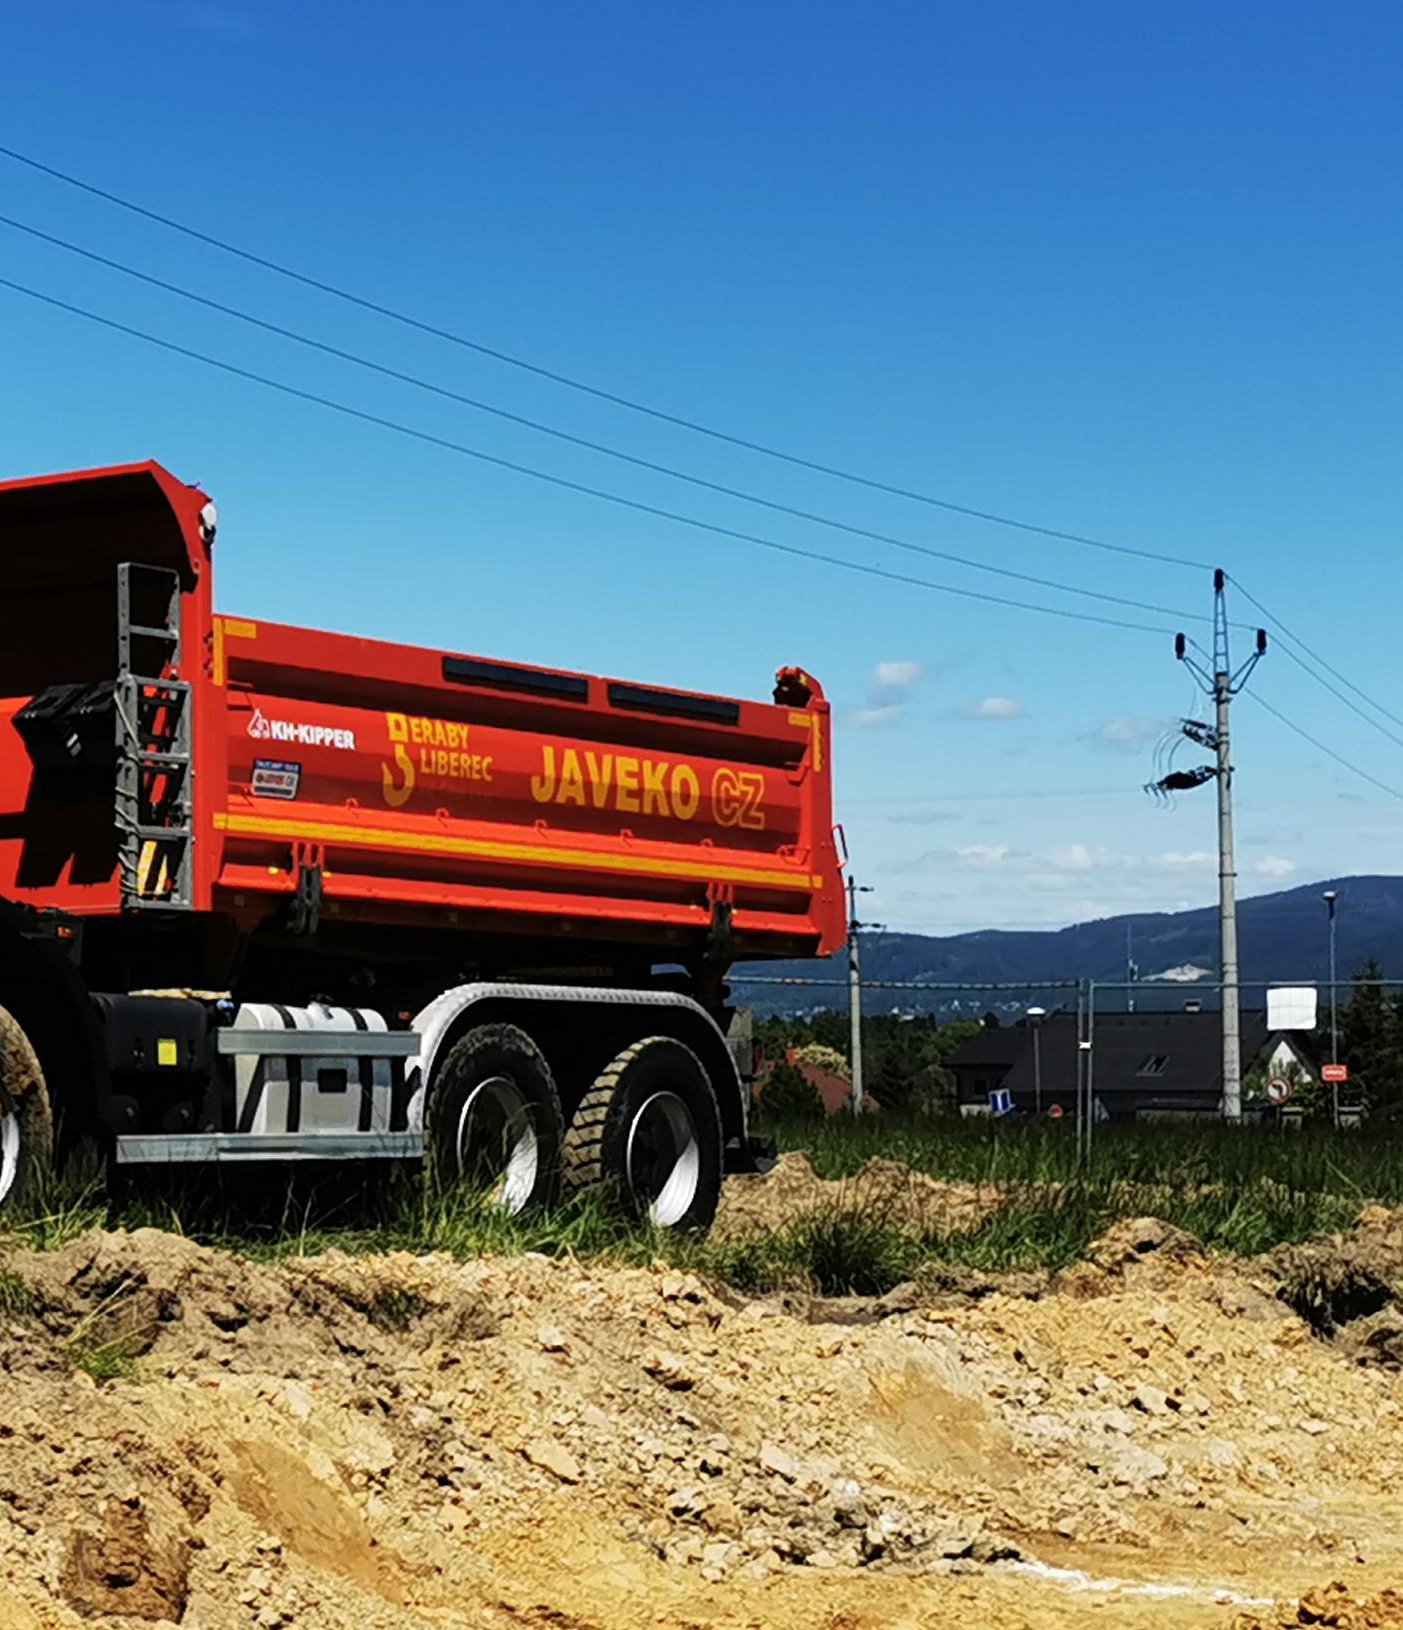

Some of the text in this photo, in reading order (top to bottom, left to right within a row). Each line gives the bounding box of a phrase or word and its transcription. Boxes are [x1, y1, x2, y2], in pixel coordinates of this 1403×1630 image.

[270, 720, 356, 750] KH-KIPPER
[420, 748, 494, 782] LIBEREC
[531, 745, 766, 830] JAVEKO CZ
